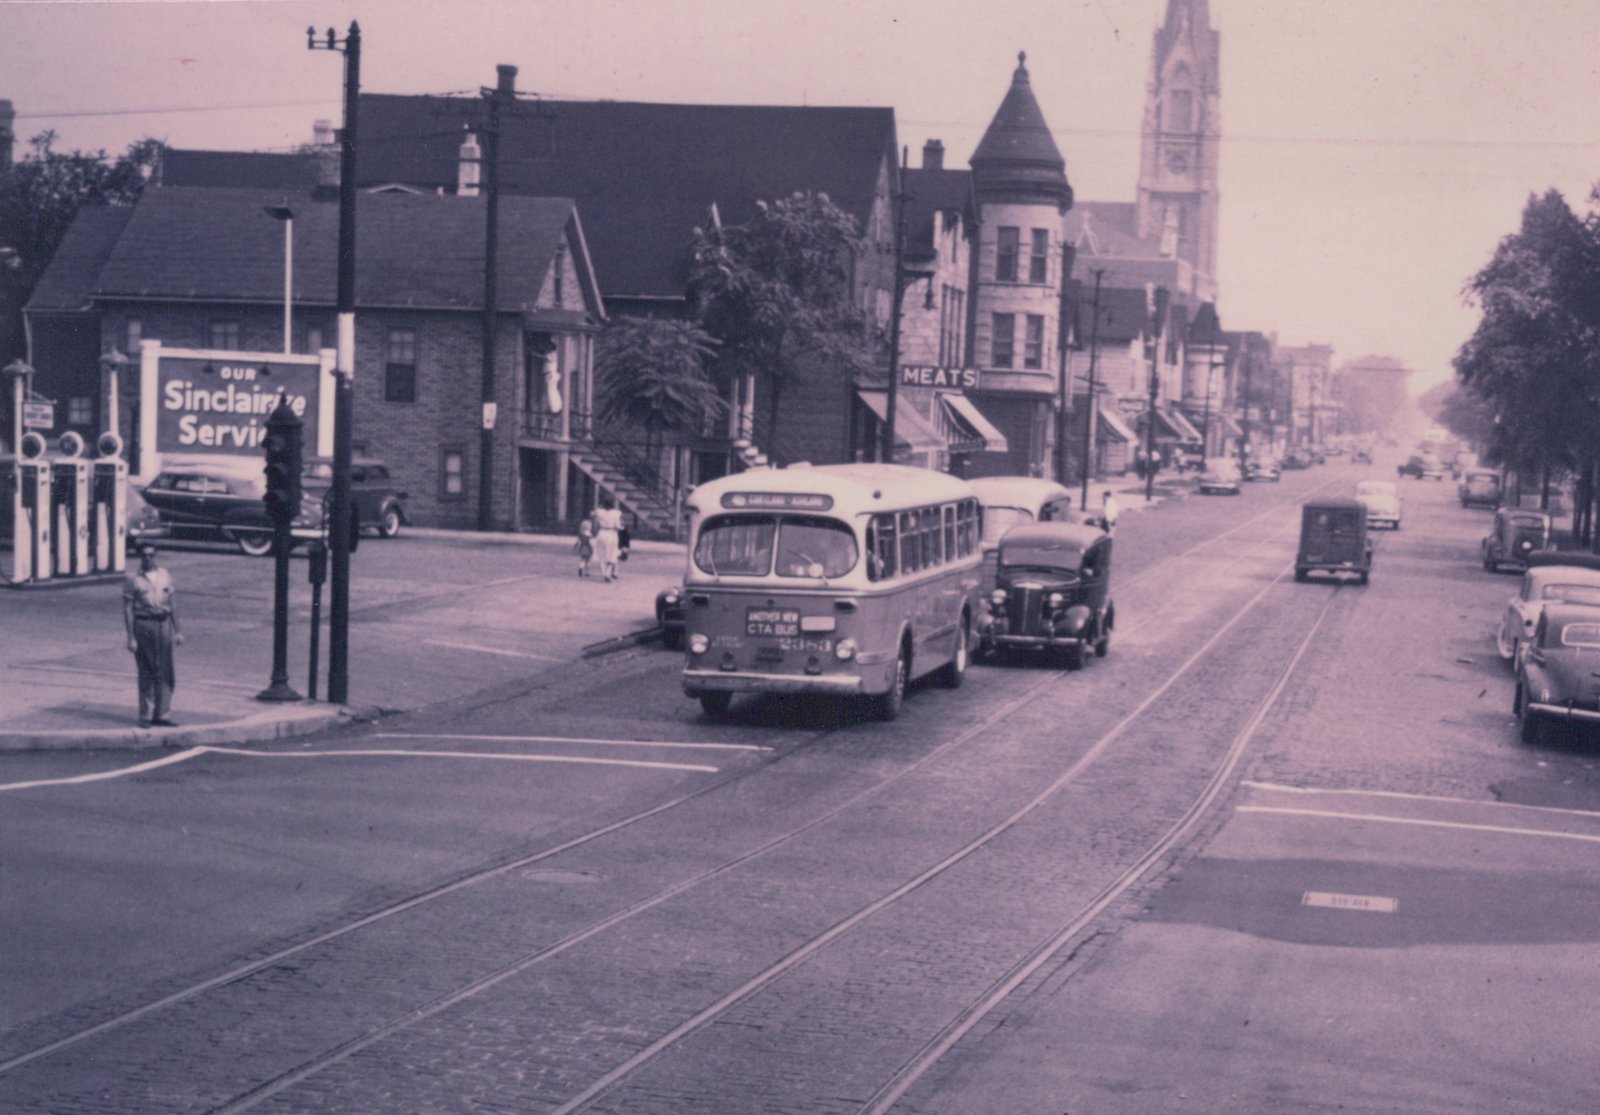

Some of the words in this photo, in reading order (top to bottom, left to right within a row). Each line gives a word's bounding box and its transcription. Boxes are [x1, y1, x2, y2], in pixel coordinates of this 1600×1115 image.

[220, 366, 256, 380] OUR
[903, 367, 976, 387] MEATS
[747, 623, 773, 634] CTA
[775, 624, 798, 636] BUS
